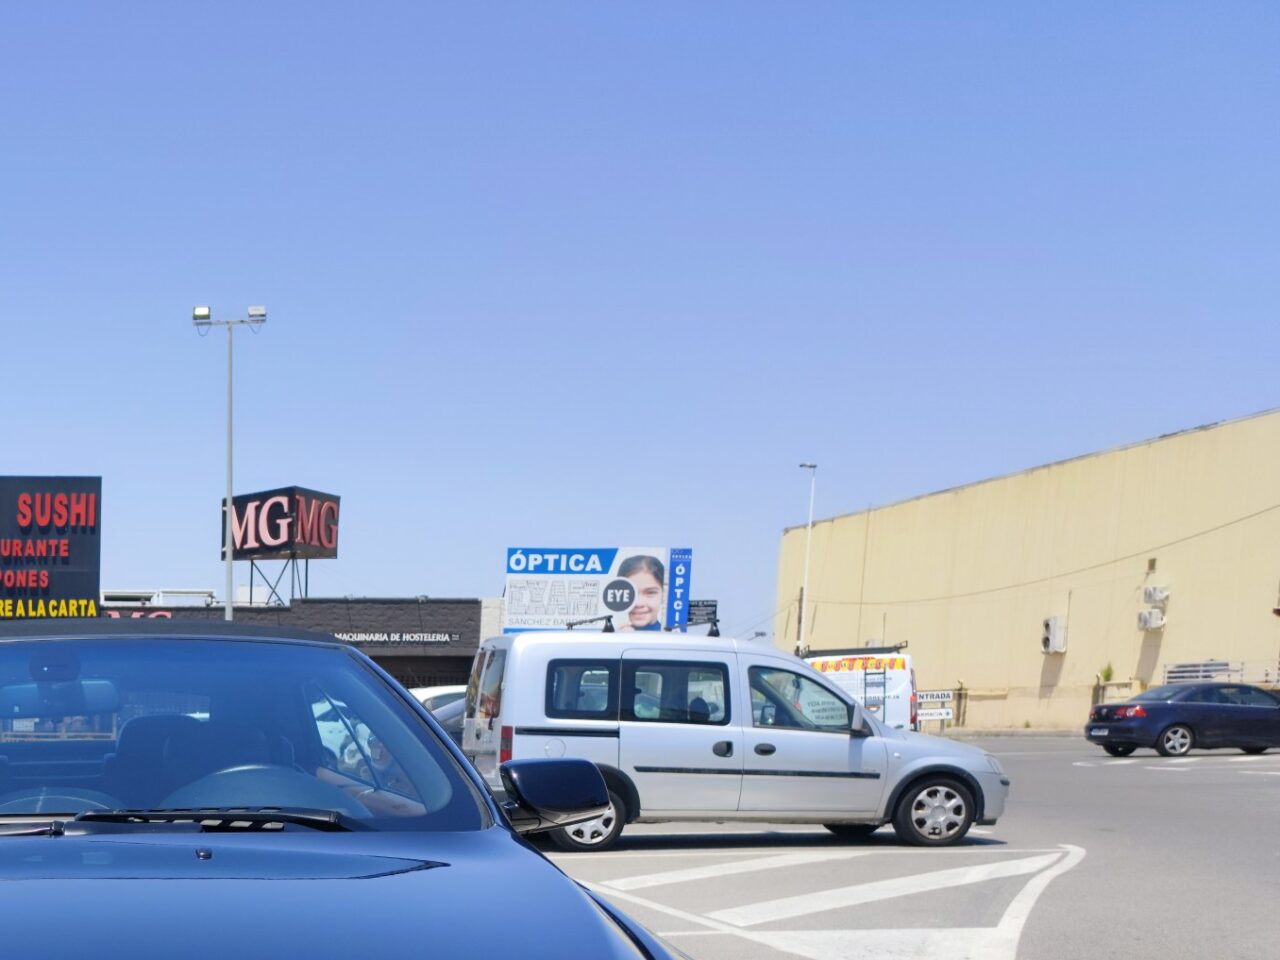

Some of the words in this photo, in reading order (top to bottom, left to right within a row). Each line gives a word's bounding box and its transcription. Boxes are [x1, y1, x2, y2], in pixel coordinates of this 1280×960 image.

[17, 492, 96, 527] SUSHI
[223, 496, 292, 551] MG
[294, 495, 338, 549] MG
[509, 550, 602, 571] ÓPTICA
[607, 589, 630, 603] EYE
[16, 600, 25, 617] A
[28, 599, 46, 617] LA
[48, 599, 97, 617] CARTA
[390, 633, 401, 642] DE
